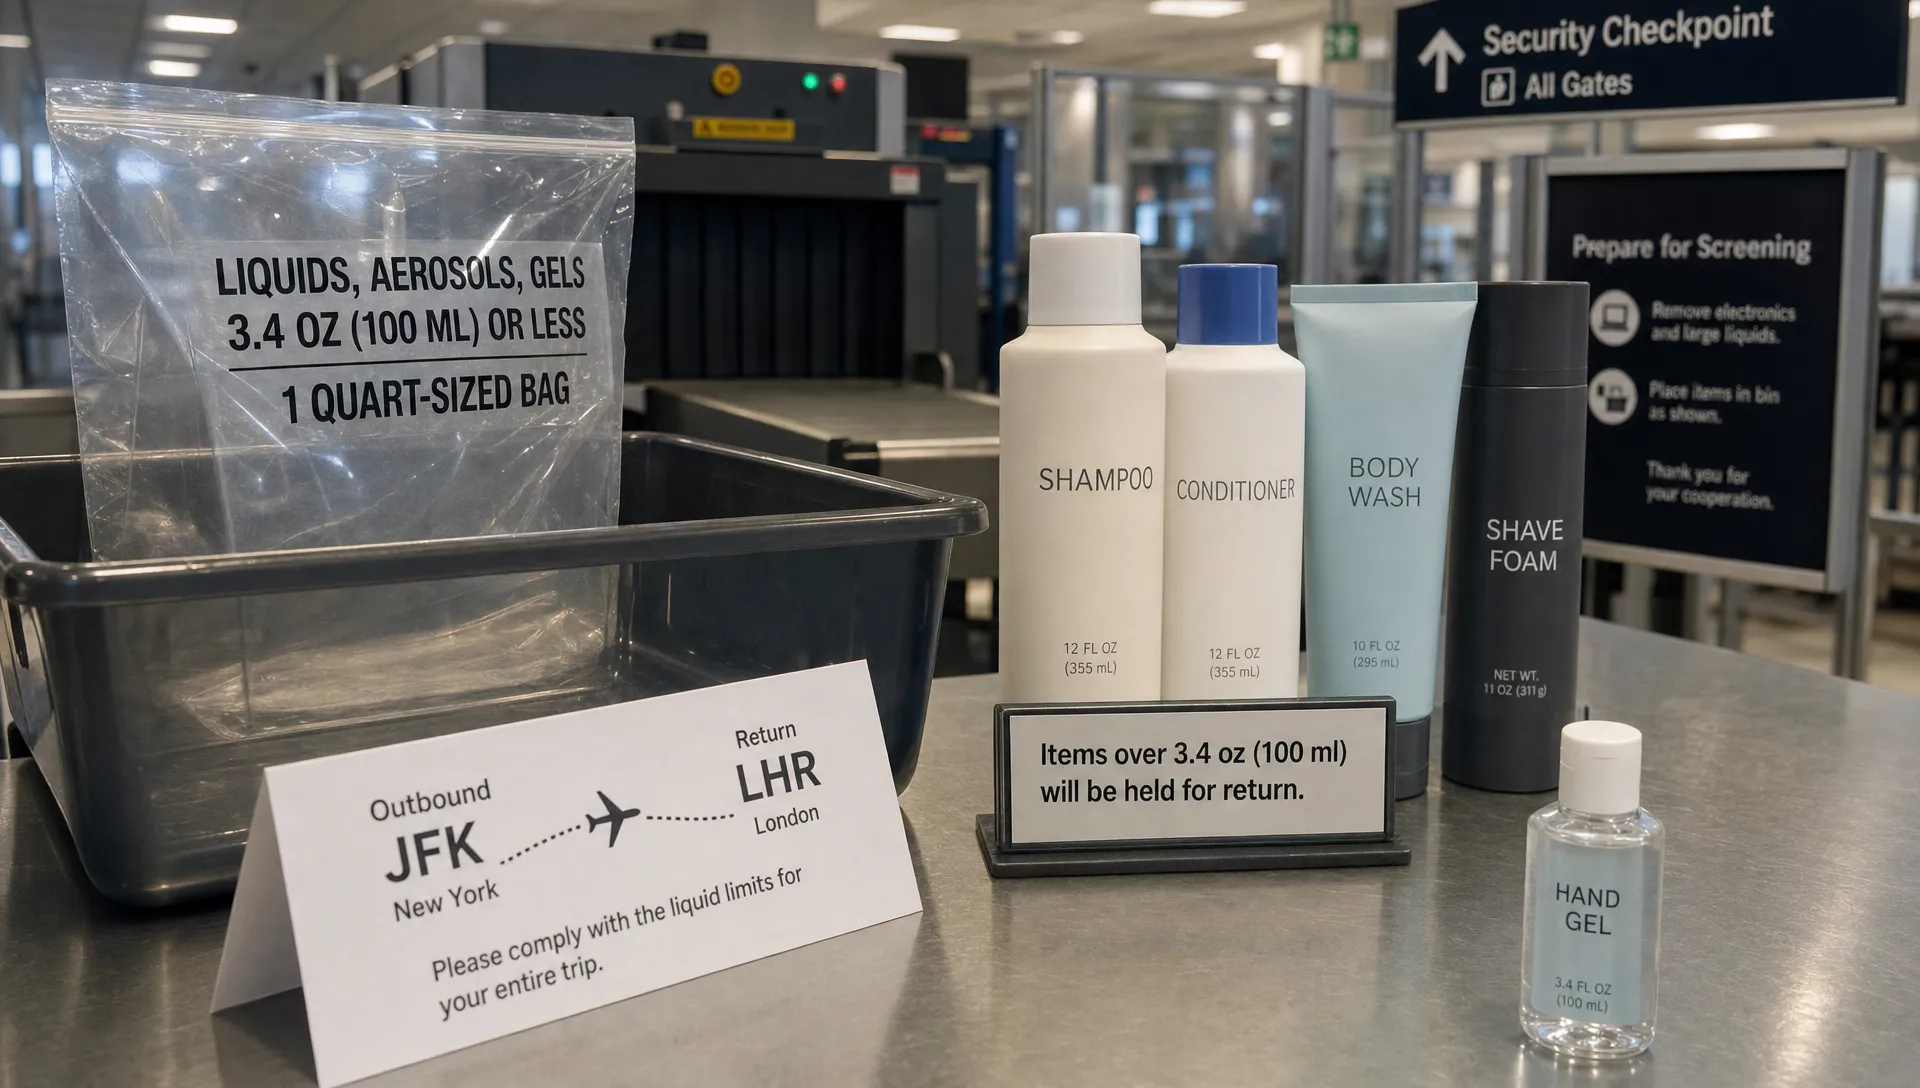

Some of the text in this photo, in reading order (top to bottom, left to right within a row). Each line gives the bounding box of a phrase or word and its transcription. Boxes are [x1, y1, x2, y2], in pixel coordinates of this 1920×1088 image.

[1482, 4, 1775, 57] Security Checkpoint
[1524, 70, 1633, 100] All Gates
[1572, 232, 1812, 266] Prepare for Screening
[215, 255, 585, 300] LIQUIDS, AEROSOLS, GELS
[1651, 300, 1797, 323] Remove electronics
[227, 306, 586, 352] 3.4 OZ (100 ML) OR LESS
[1650, 323, 1781, 347] and large liquids.
[281, 370, 570, 425] 1 QUART-SIZED BAG
[1648, 379, 1781, 404] Place items in bin
[1648, 405, 1722, 424] as shown.
[1039, 465, 1153, 492] SHAMPOO
[1350, 456, 1419, 478] BODY
[1647, 459, 1750, 487] Thank you for
[1176, 478, 1295, 501] CONDITIONER
[1348, 486, 1421, 508] WASH
[1646, 486, 1774, 511] your cooperation.
[1486, 518, 1564, 542] SHAVE
[1490, 549, 1557, 572] FOAM
[1064, 641, 1118, 655] 12 FL OZ
[1209, 647, 1260, 660] 12 FL OZ
[1352, 640, 1401, 652] 10 FL OZ
[1064, 660, 1117, 677] (355 mL)
[1209, 664, 1260, 680] (355 mL)
[1353, 656, 1399, 669] (295 mL)
[1494, 668, 1540, 682] NET WT.
[1483, 682, 1495, 695] 11
[1496, 684, 1513, 696] OZ
[735, 723, 797, 749] Return
[1041, 739, 1347, 768] Items over 3.4 oz (100 ml)
[736, 749, 821, 802] LHR
[370, 779, 491, 822] Outbound
[1040, 777, 1304, 803] will be held for return.
[754, 807, 820, 835] London
[385, 821, 484, 883] JFK
[393, 879, 500, 922] New York
[1556, 882, 1620, 909] HAND
[432, 867, 802, 982] Please comply with the liquid limits for
[1565, 911, 1612, 936] GEL
[439, 955, 603, 1022] your entire trip.
[1554, 976, 1612, 996] 3.4 FL OZ
[1556, 993, 1608, 1014] (100 mL)
